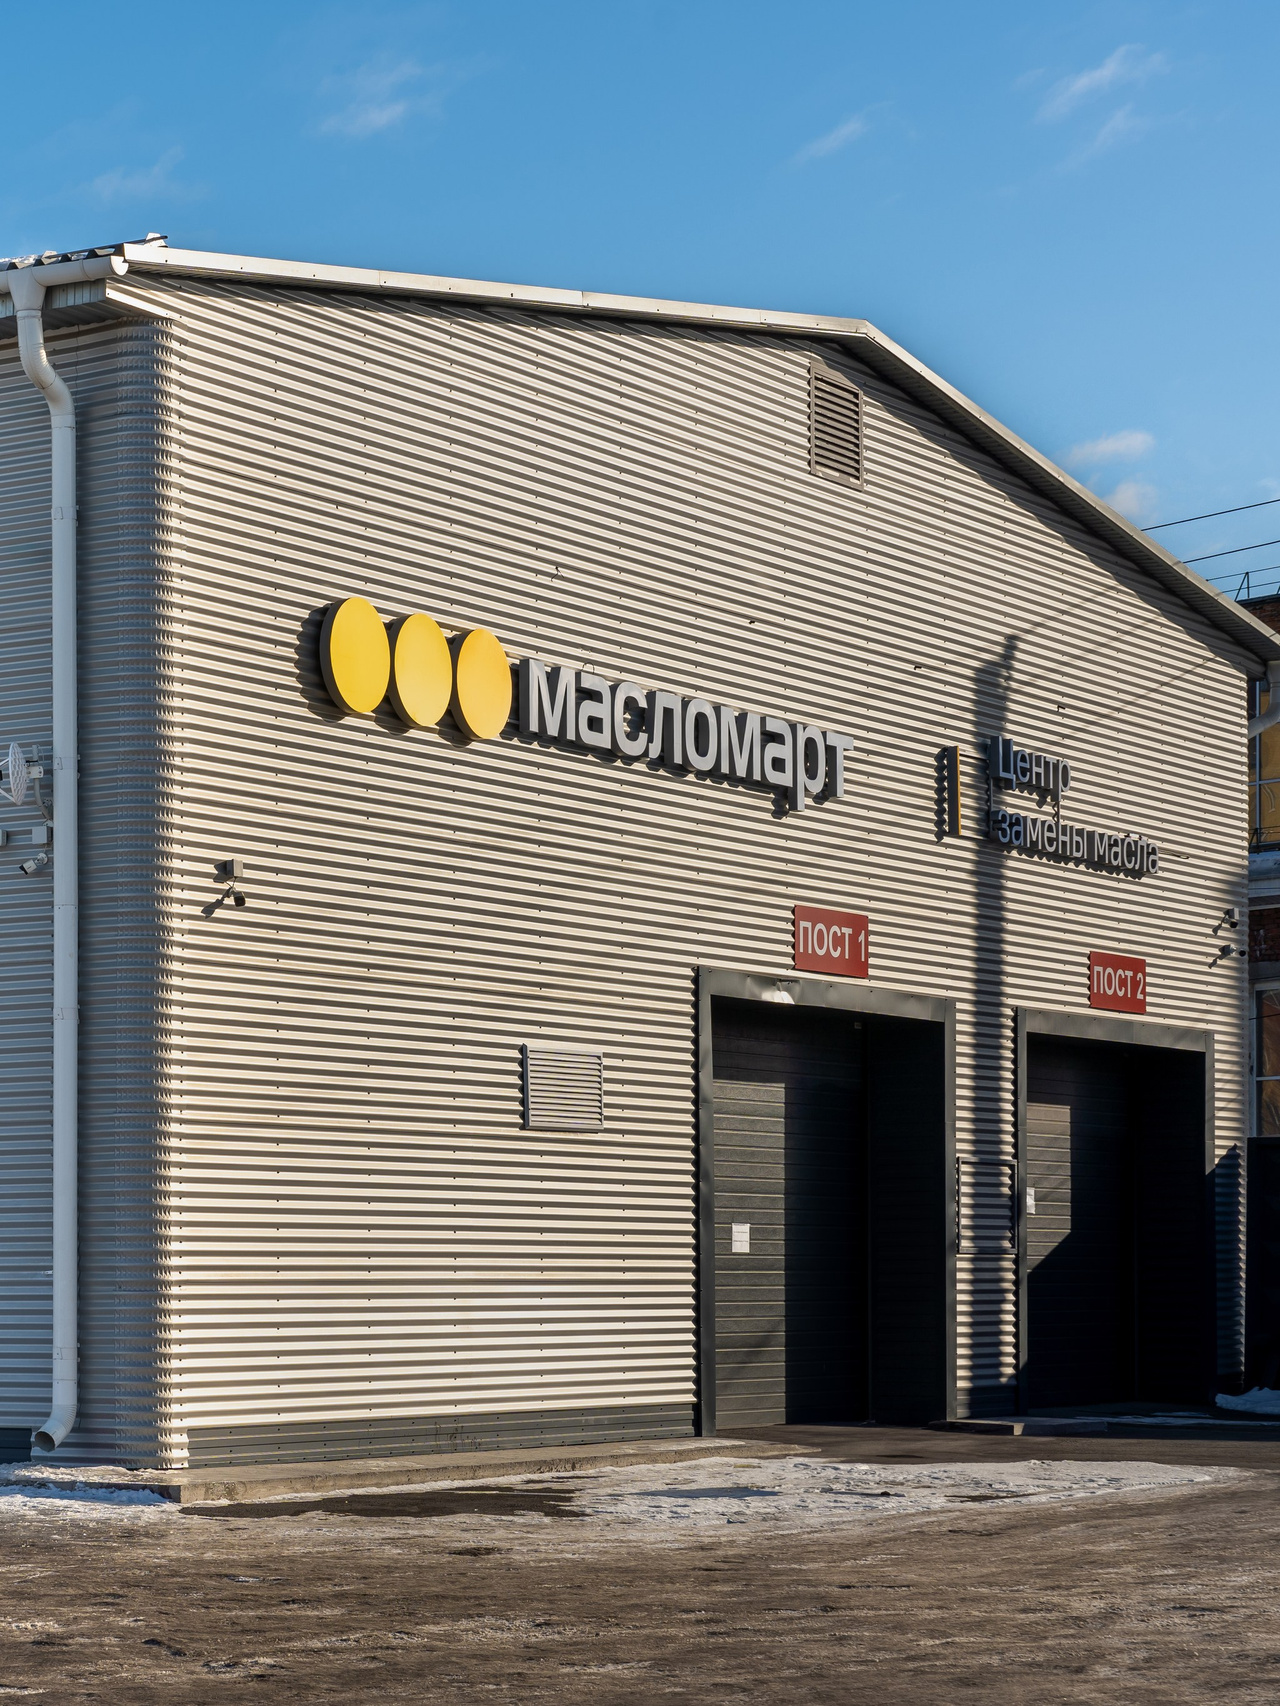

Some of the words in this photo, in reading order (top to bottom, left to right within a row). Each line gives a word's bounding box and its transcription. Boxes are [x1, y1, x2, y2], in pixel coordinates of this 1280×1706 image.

[520, 658, 854, 811] масломарт
[992, 736, 1071, 802] Центр
[995, 809, 1088, 859] замены
[1094, 829, 1159, 874] масла
[799, 920, 853, 959] ПОСТ
[857, 930, 866, 962] 1
[1093, 966, 1133, 998] ПОСТ
[1136, 974, 1145, 1000] 2
